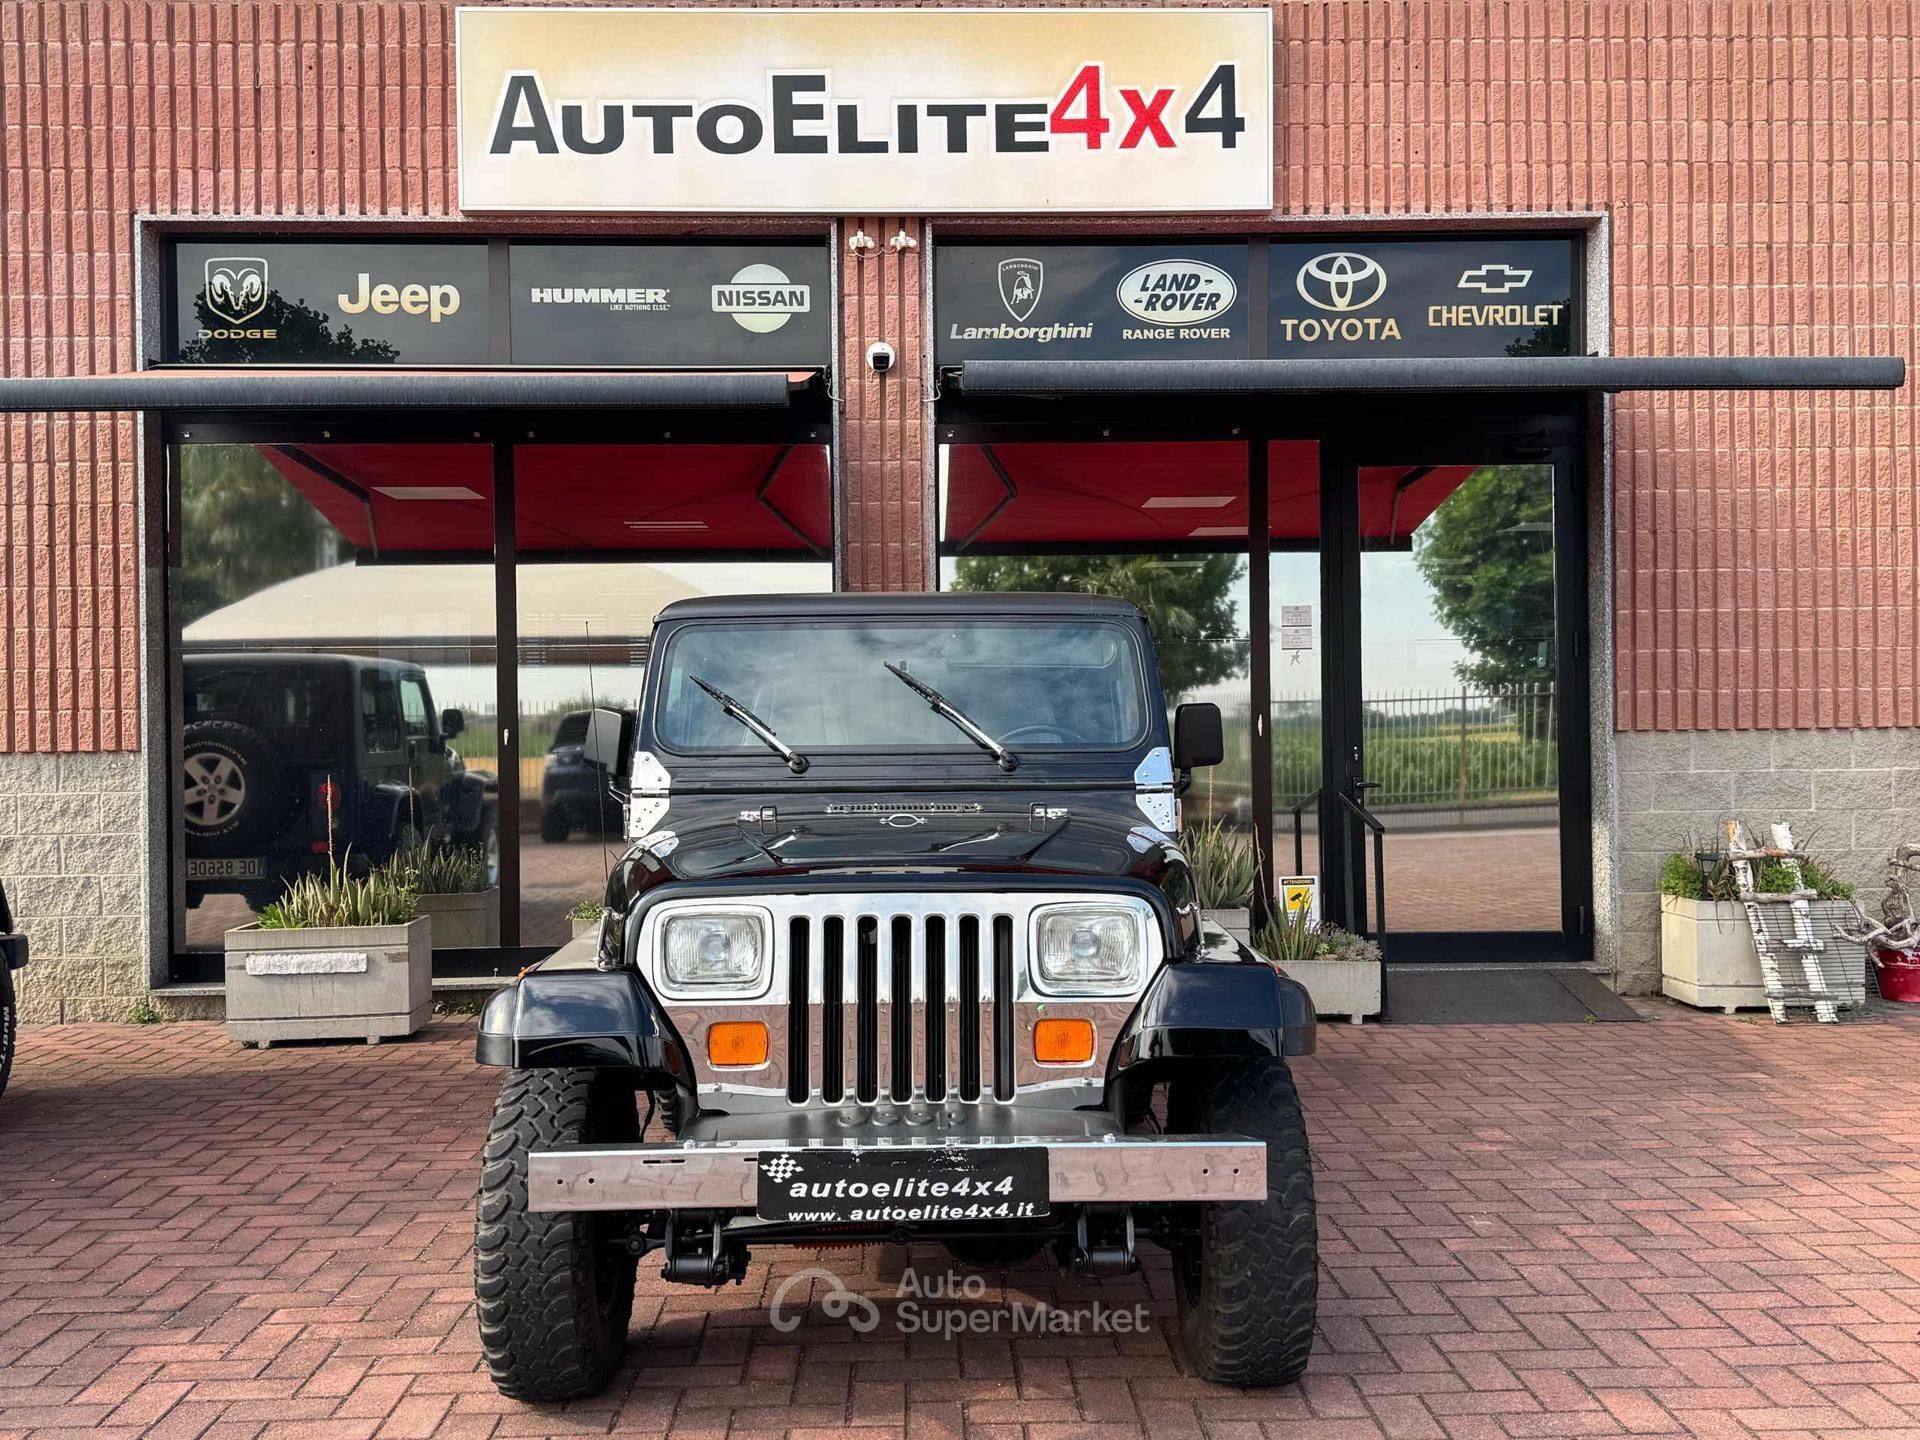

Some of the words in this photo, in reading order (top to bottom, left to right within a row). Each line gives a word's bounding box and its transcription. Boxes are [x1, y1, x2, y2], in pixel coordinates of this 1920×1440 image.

[337, 273, 461, 323] Jeep
[531, 288, 668, 304] HUMMER
[717, 290, 805, 307] NISSAN
[1428, 304, 1564, 327] CHEVROLET
[197, 329, 278, 340] DODGE
[949, 322, 1094, 343] Lamborghini
[1122, 328, 1175, 340] RANGE
[1179, 328, 1231, 340] ROVER
[1280, 317, 1402, 342] TOYOTA
[789, 1175, 1014, 1199] autoelite4x4
